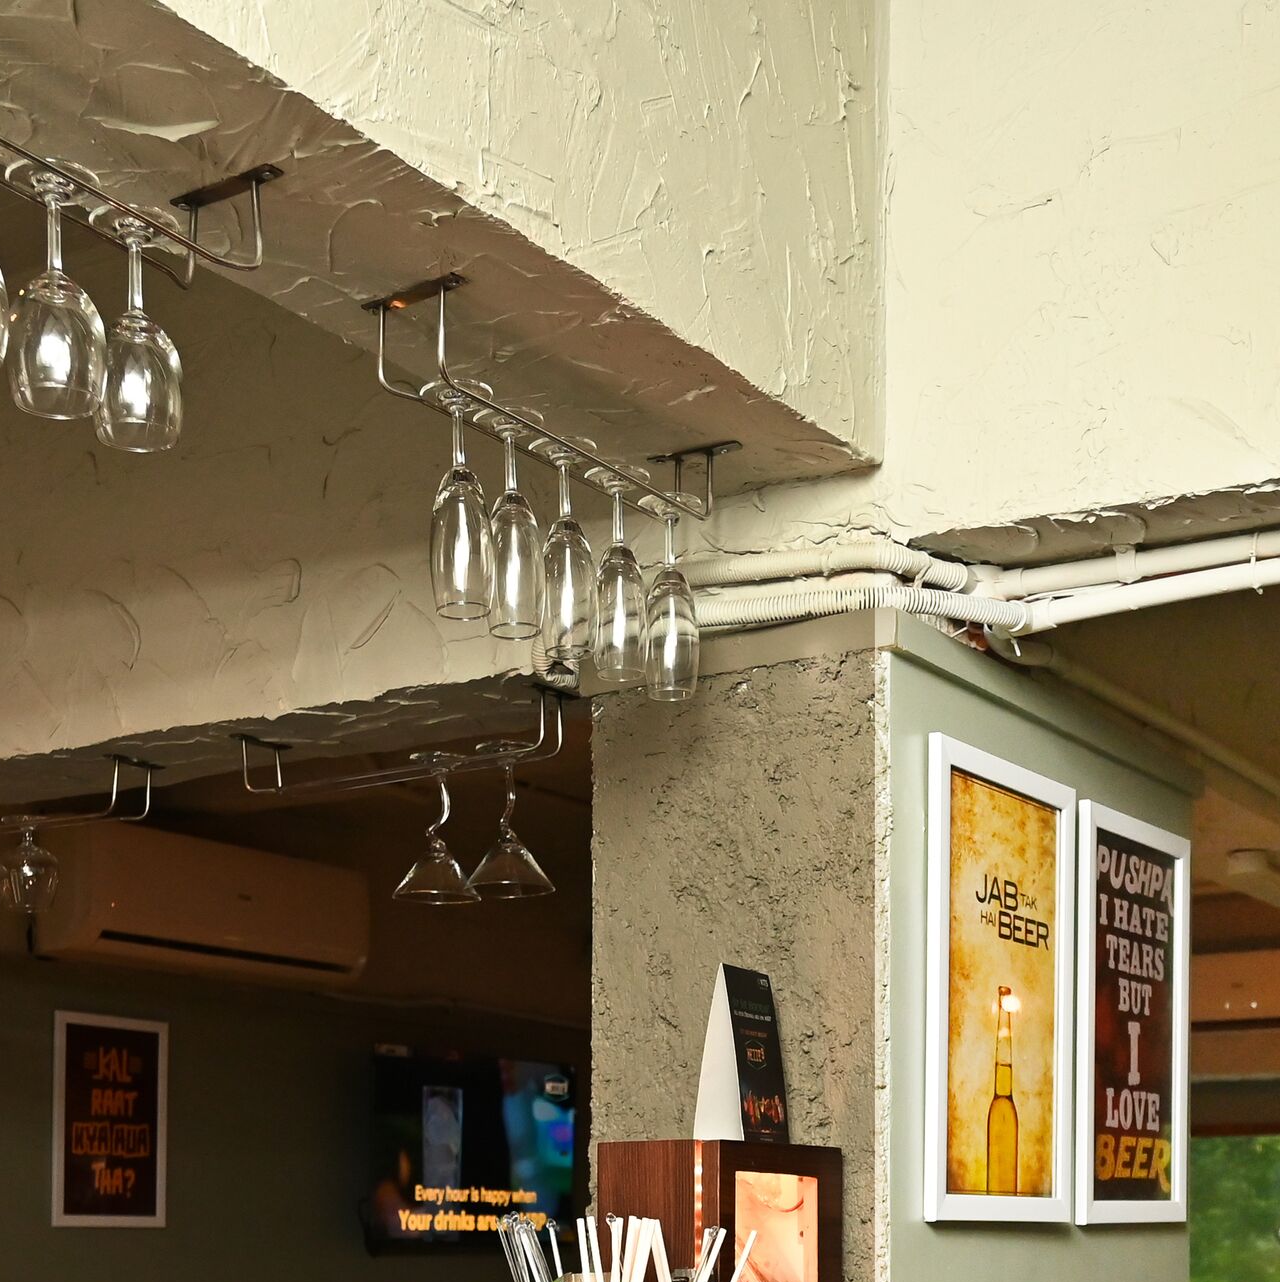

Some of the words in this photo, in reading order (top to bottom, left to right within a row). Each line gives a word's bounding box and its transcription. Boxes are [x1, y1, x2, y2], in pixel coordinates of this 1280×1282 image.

[975, 874, 1018, 912] JAB
[1020, 893, 1038, 911] TAK
[1097, 845, 1174, 917] PUSHPA
[980, 910, 997, 927] HAI
[998, 910, 1049, 951] BEER
[1099, 893, 1108, 925] I
[1114, 898, 1168, 943] HATE
[1106, 934, 1164, 981] TEARS
[1118, 977, 1152, 1016] BUT
[1127, 1021, 1141, 1086] I
[1106, 1088, 1160, 1132] LOVE
[1095, 1134, 1172, 1194] BEER
[414, 1184, 445, 1205] Every
[445, 1186, 469, 1202] hour
[470, 1186, 479, 1202] is
[480, 1187, 511, 1207] happy
[398, 1209, 433, 1231] Your
[433, 1210, 475, 1231] drinks
